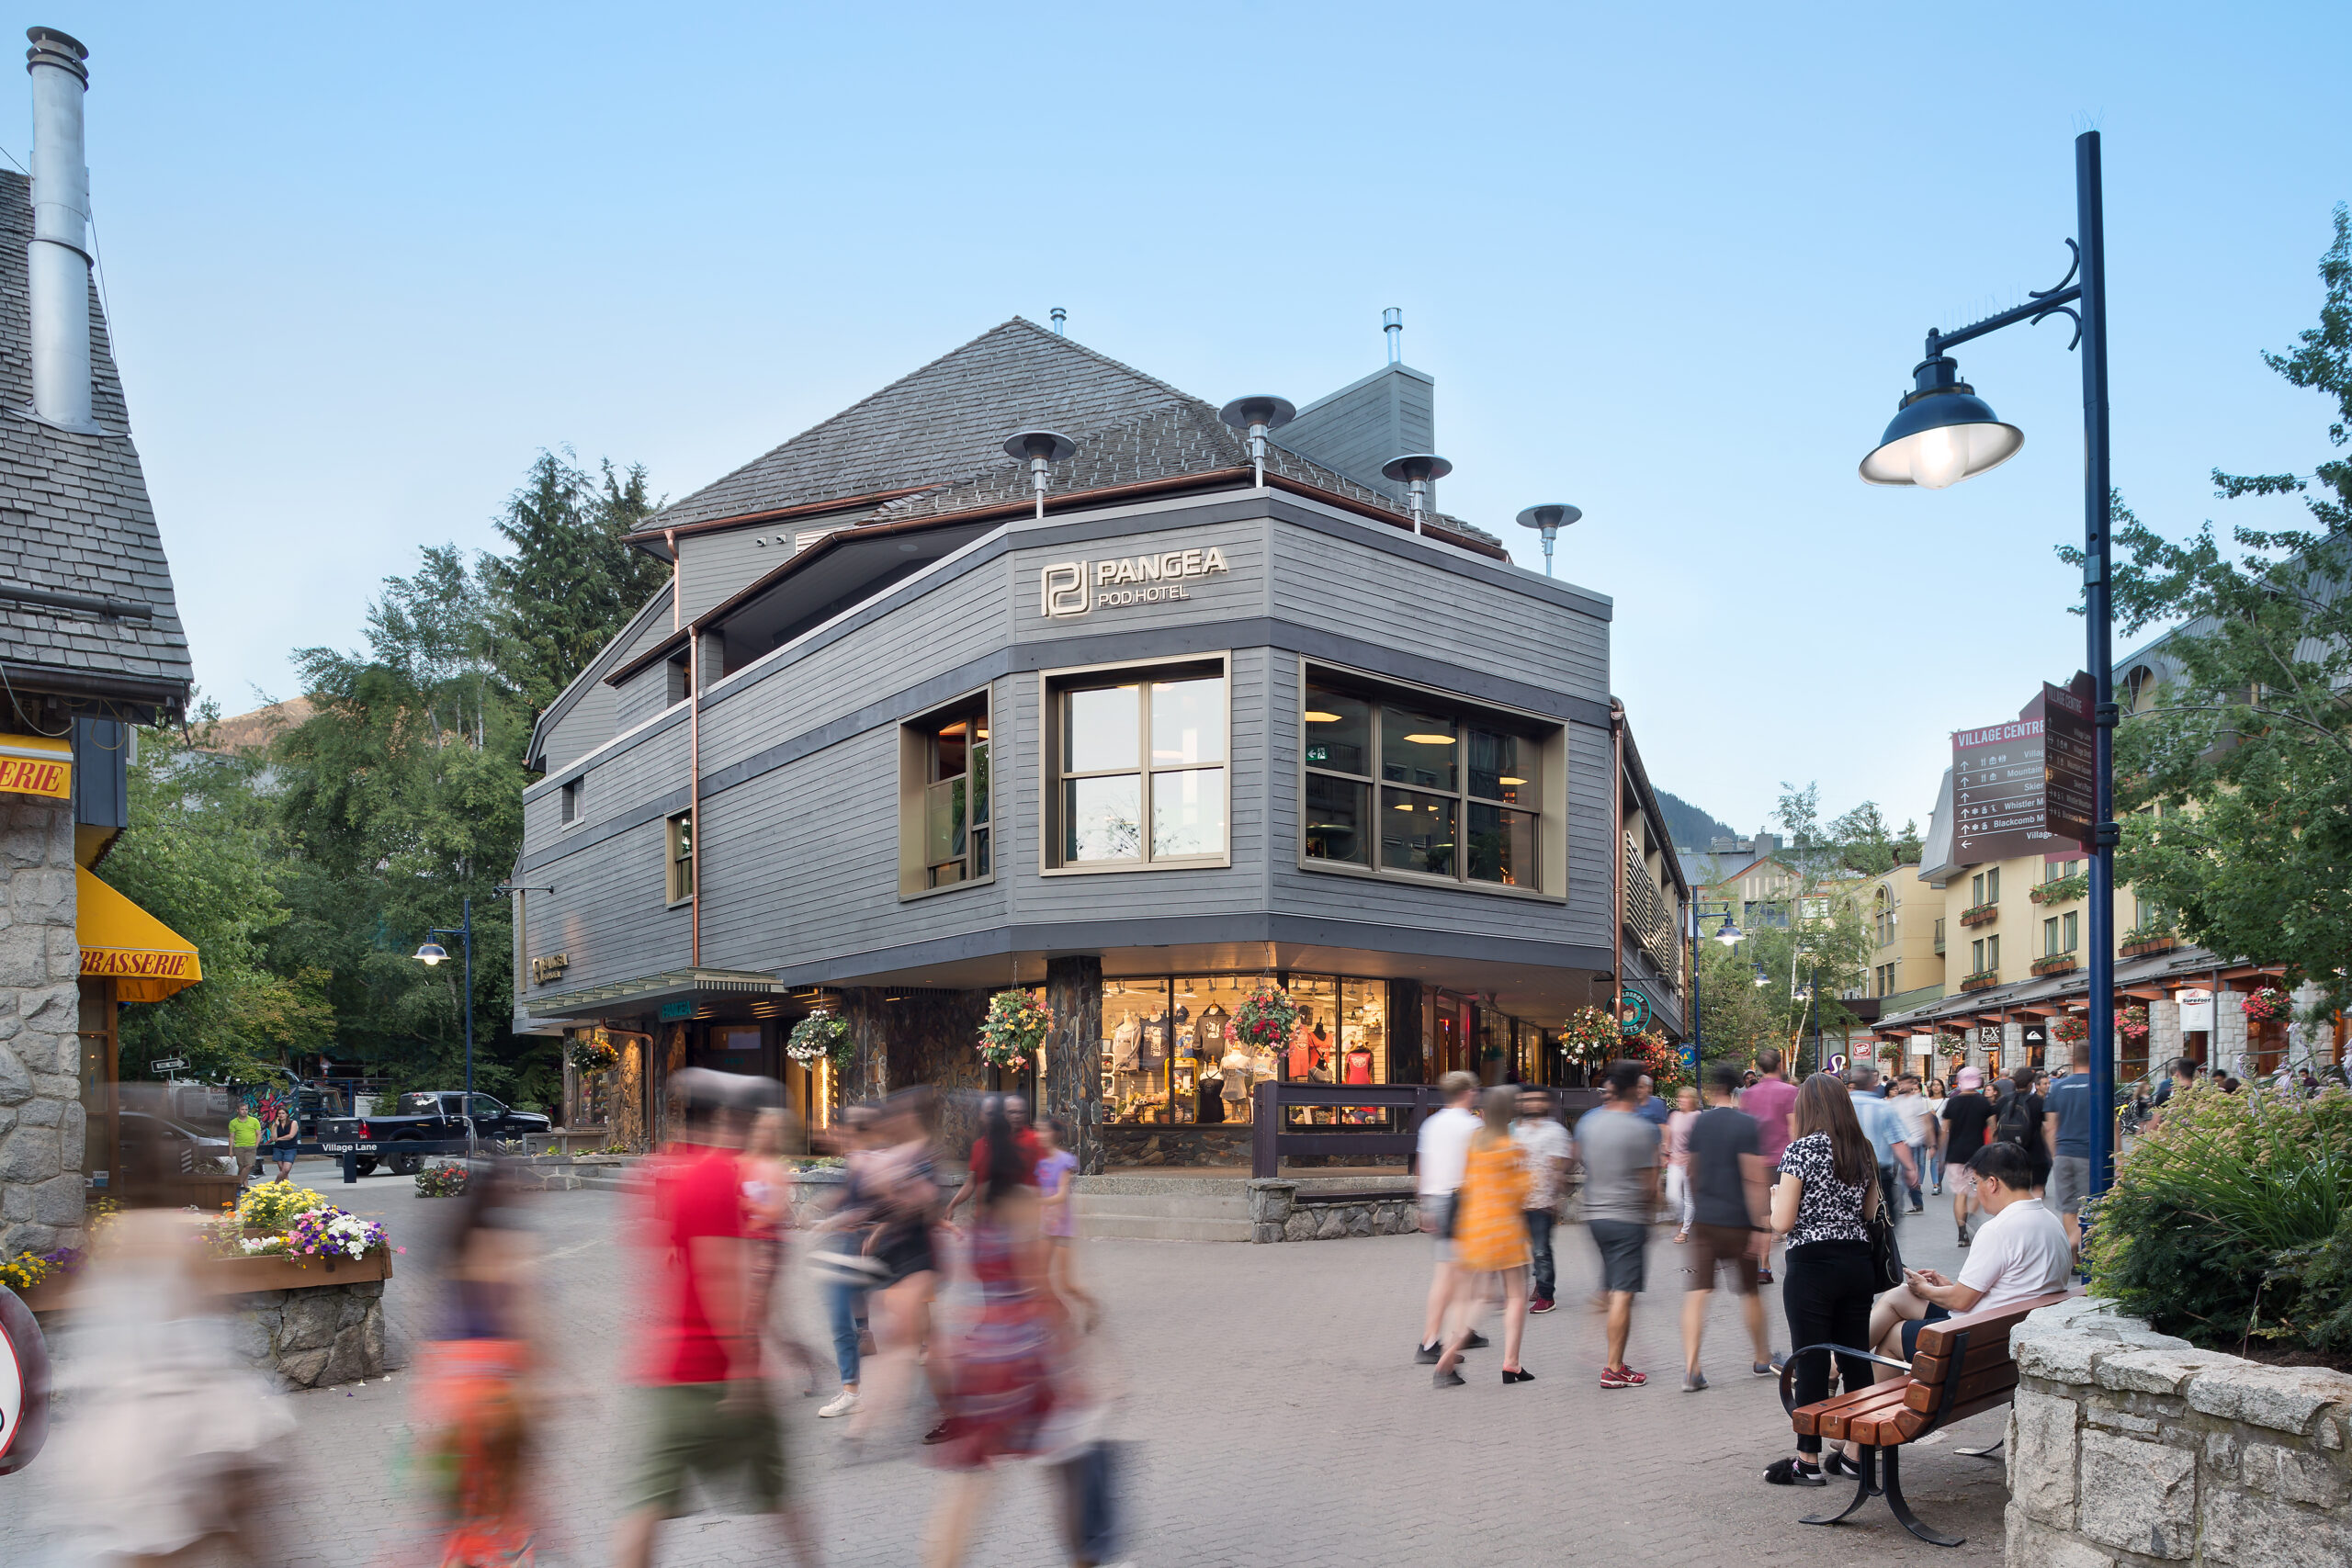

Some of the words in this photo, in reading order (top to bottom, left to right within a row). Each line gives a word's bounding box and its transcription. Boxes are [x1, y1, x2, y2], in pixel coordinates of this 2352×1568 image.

[1097, 547, 1228, 586] PANGEA
[1099, 591, 1133, 607] POD
[1135, 584, 1191, 603] HOTEL
[1958, 728, 2002, 747] VILLAGE
[2004, 720, 2044, 739] CENTRE
[2024, 749, 2044, 759] Villag
[2007, 765, 2043, 778] Mountain
[2024, 782, 2044, 792] Skier
[2004, 799, 2035, 810] Whistler
[1994, 816, 2035, 829] Blackcomb
[80, 951, 189, 976] BRASSERIE
[662, 1000, 692, 1019] PANGEA
[322, 1144, 353, 1153] Village
[355, 1143, 378, 1151] Lane
